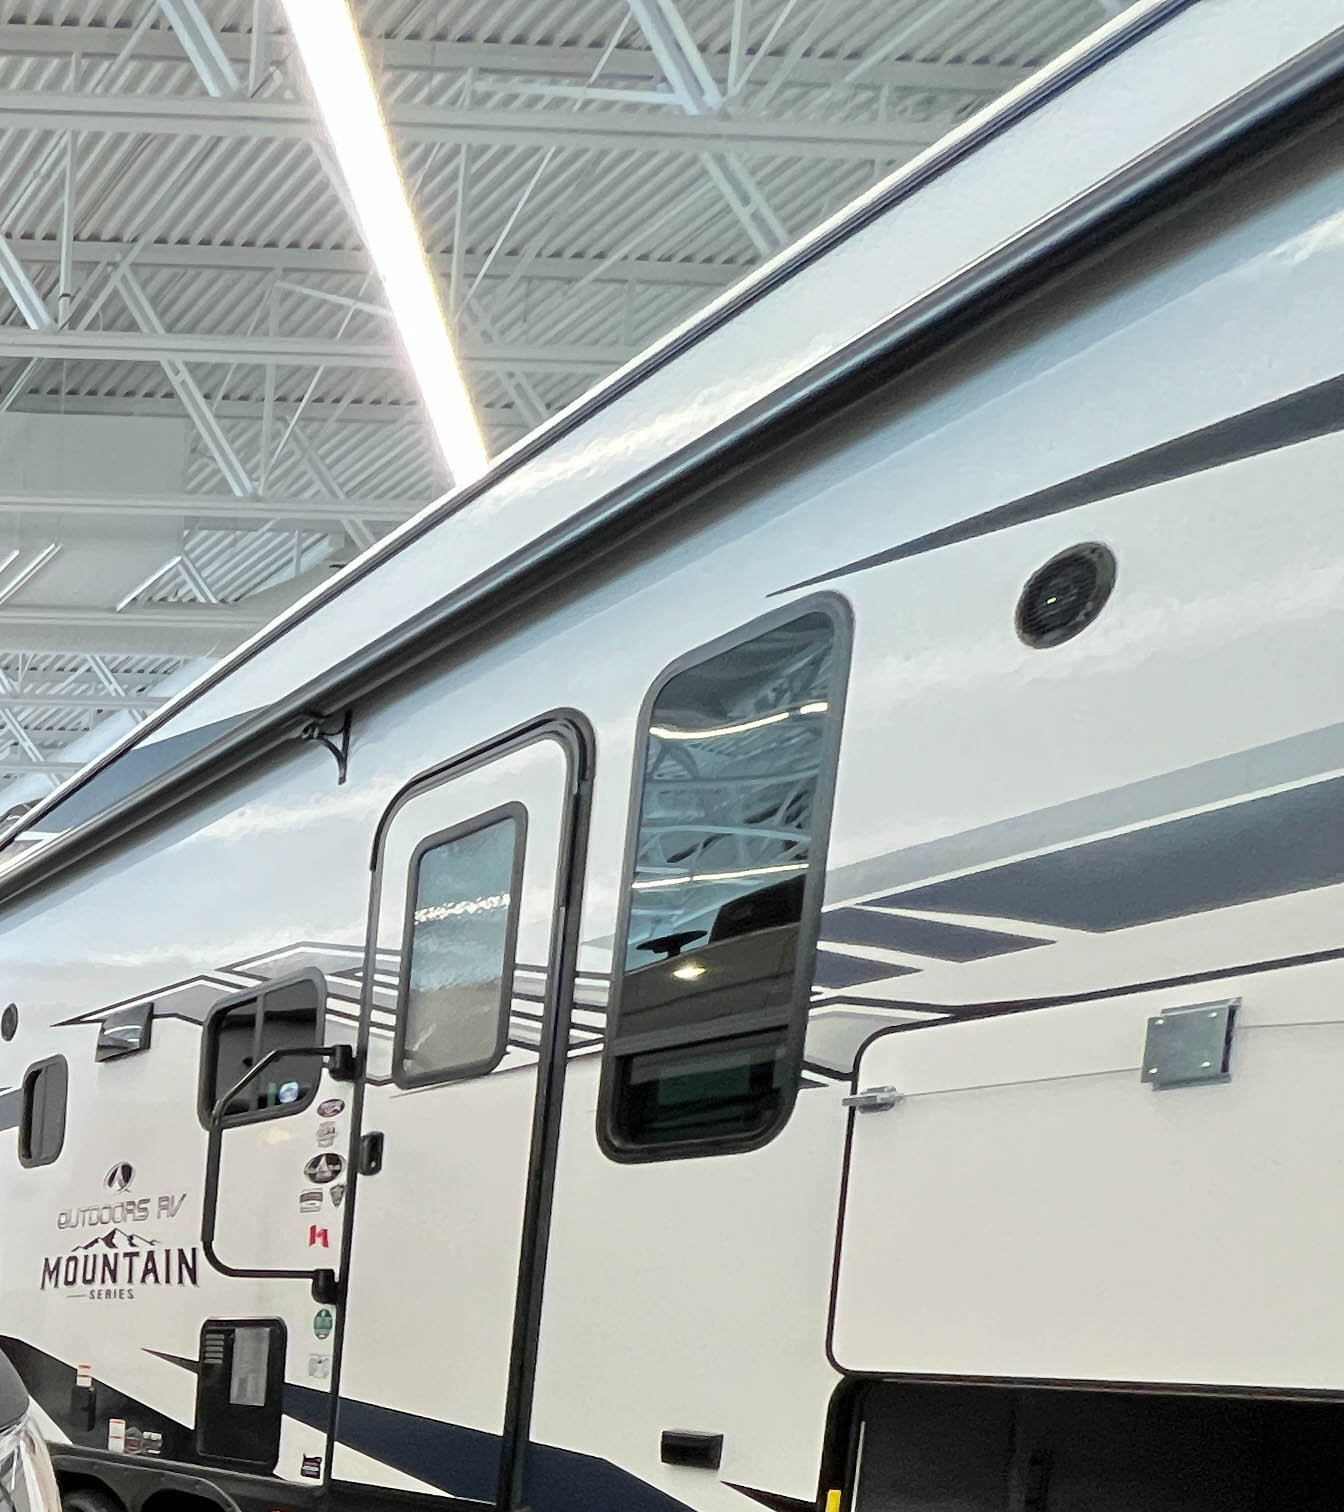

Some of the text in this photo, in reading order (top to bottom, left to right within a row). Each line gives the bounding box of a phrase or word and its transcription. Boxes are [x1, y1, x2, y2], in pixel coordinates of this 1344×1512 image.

[57, 1193, 187, 1229] OUTDOORS RV
[40, 1247, 200, 1290] MOUNTAIN
[89, 1288, 135, 1300] SERIES
